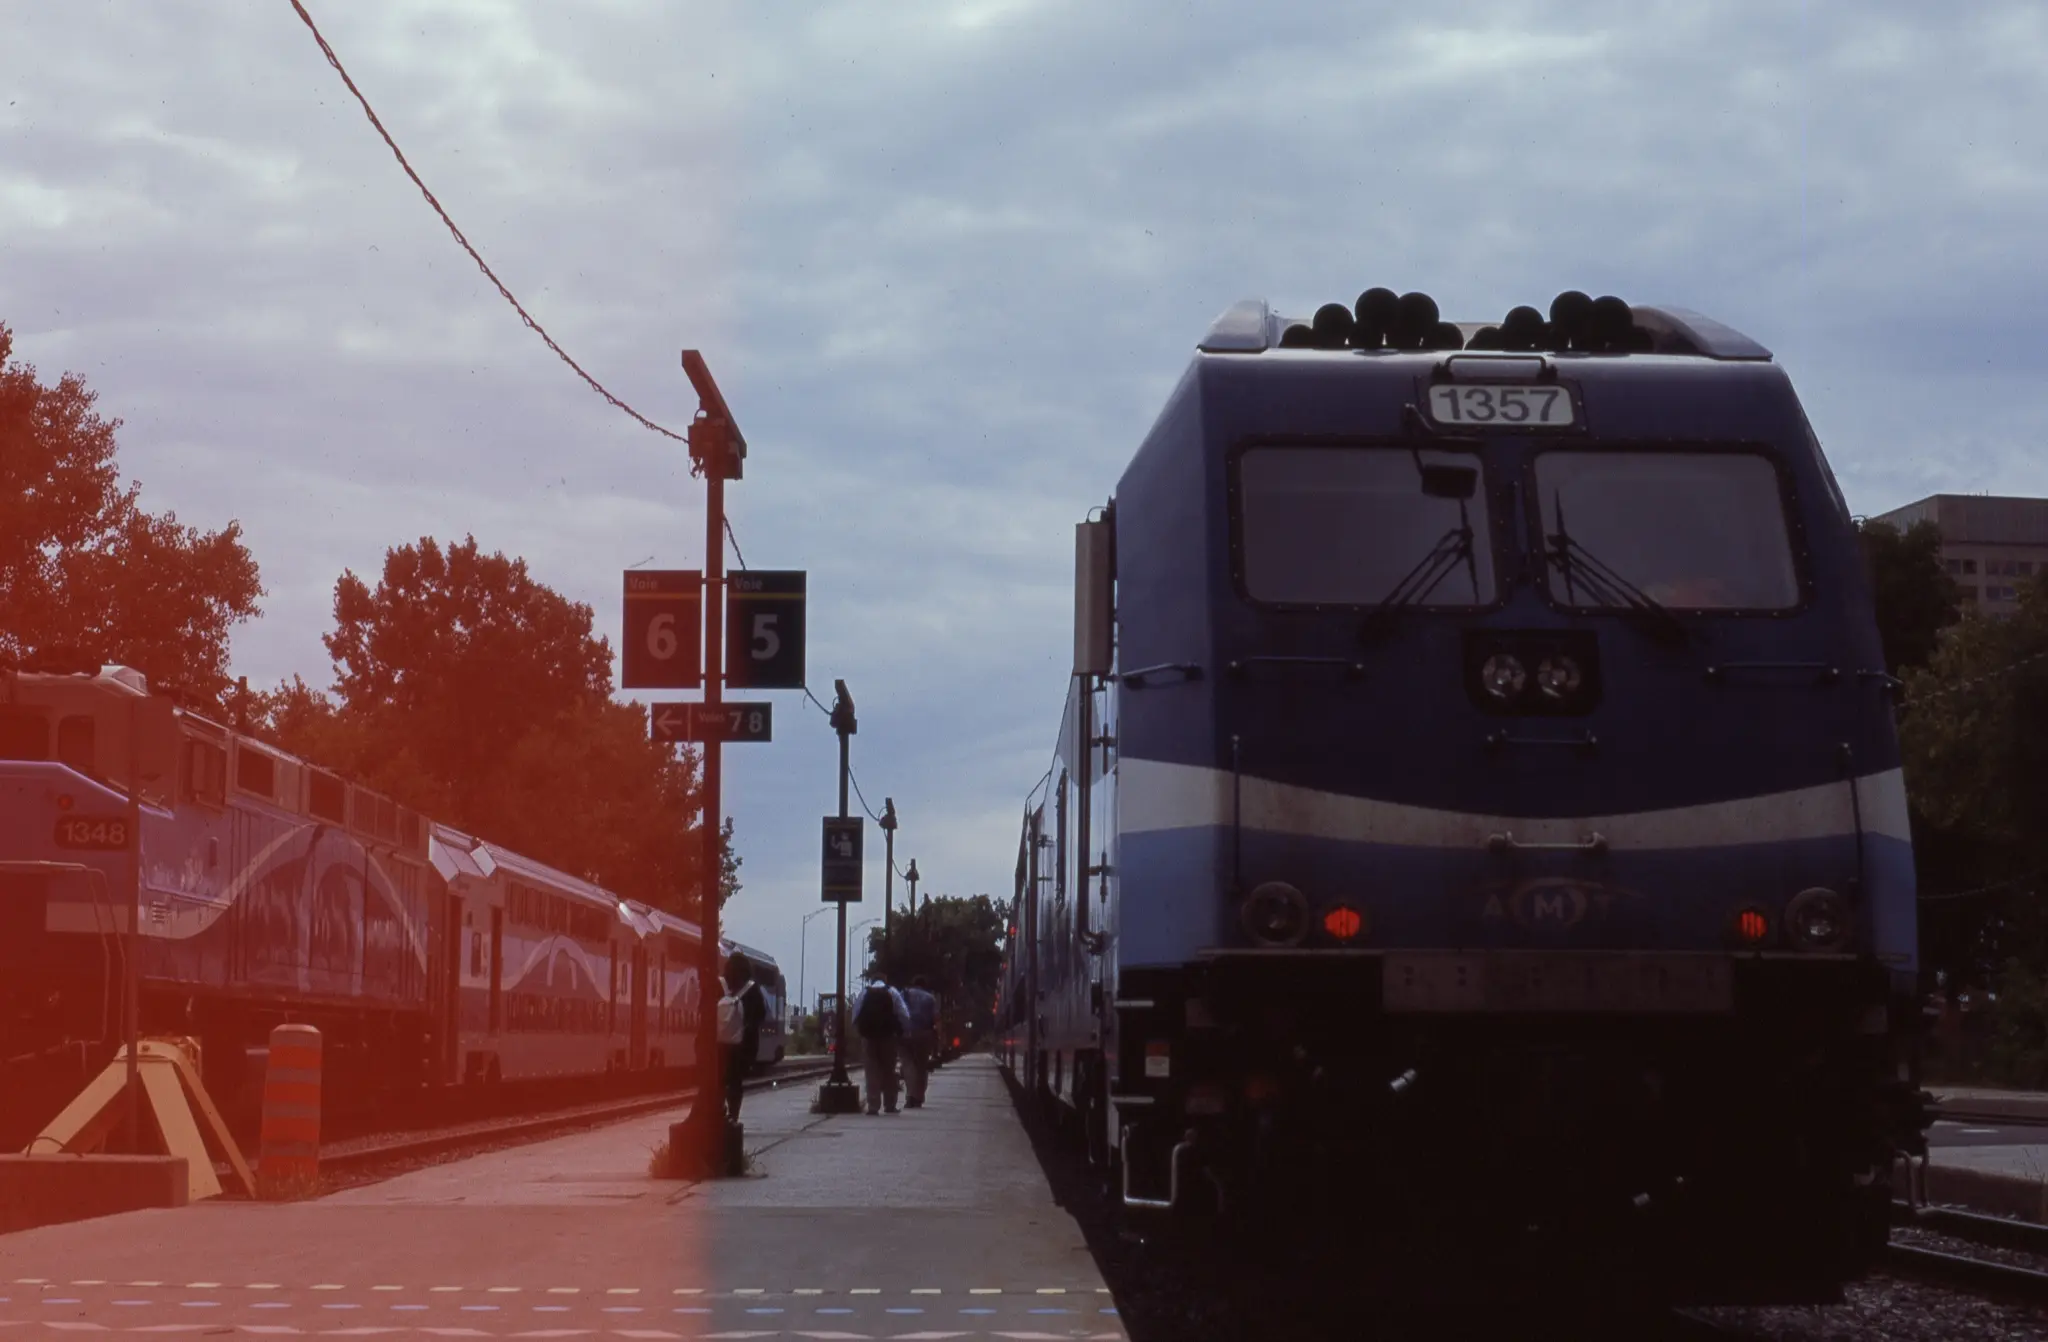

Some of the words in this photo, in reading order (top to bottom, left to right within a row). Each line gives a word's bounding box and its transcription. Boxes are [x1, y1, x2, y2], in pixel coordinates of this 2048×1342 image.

[1439, 388, 1560, 422] 1357
[630, 577, 658, 590] Voie
[734, 577, 764, 590] Voie
[646, 613, 678, 660] 6
[750, 613, 780, 660] 5
[63, 821, 125, 845] 1348
